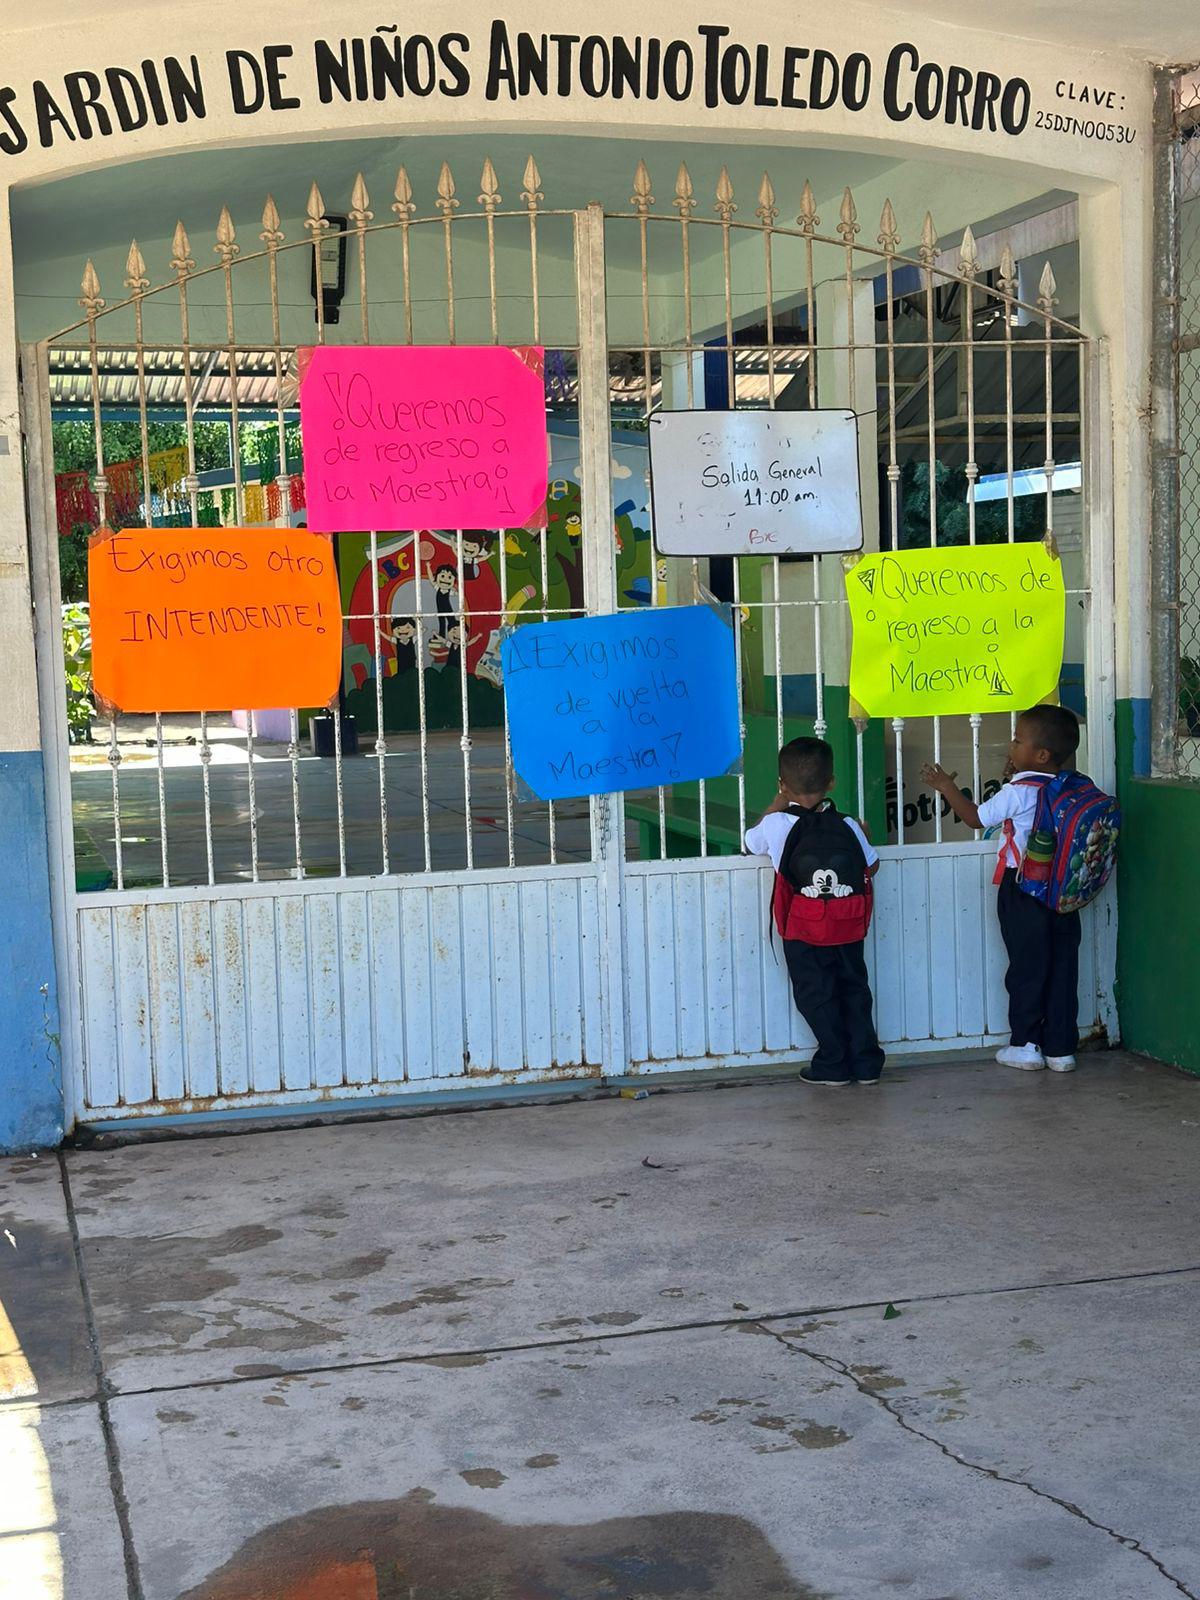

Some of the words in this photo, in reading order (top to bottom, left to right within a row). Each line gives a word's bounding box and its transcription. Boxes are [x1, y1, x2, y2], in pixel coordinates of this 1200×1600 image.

[0, 54, 206, 156] JARDIN
[225, 44, 301, 115] DE
[314, 24, 470, 104] NIÑOS
[485, 19, 694, 102] ANTONIO
[697, 25, 871, 112] TOLEDO
[883, 42, 1031, 136] CORRO
[1056, 80, 1125, 110] CLAVE:
[324, 436, 360, 465] de
[375, 437, 479, 474] regreso
[492, 439, 510, 454] a
[701, 461, 760, 488] Salida
[768, 456, 823, 480] General
[324, 480, 355, 503] la
[744, 487, 789, 506] 11:00
[108, 537, 248, 583] Exigimos
[267, 545, 324, 576] otro
[1020, 558, 1056, 592] de
[120, 602, 326, 642] INTENDENTE!
[887, 614, 971, 654] regreso
[982, 618, 999, 635] a
[1014, 608, 1034, 629] la
[555, 691, 593, 716] de
[608, 670, 689, 709] vuelta
[582, 719, 608, 734] a
[628, 707, 660, 727] la
